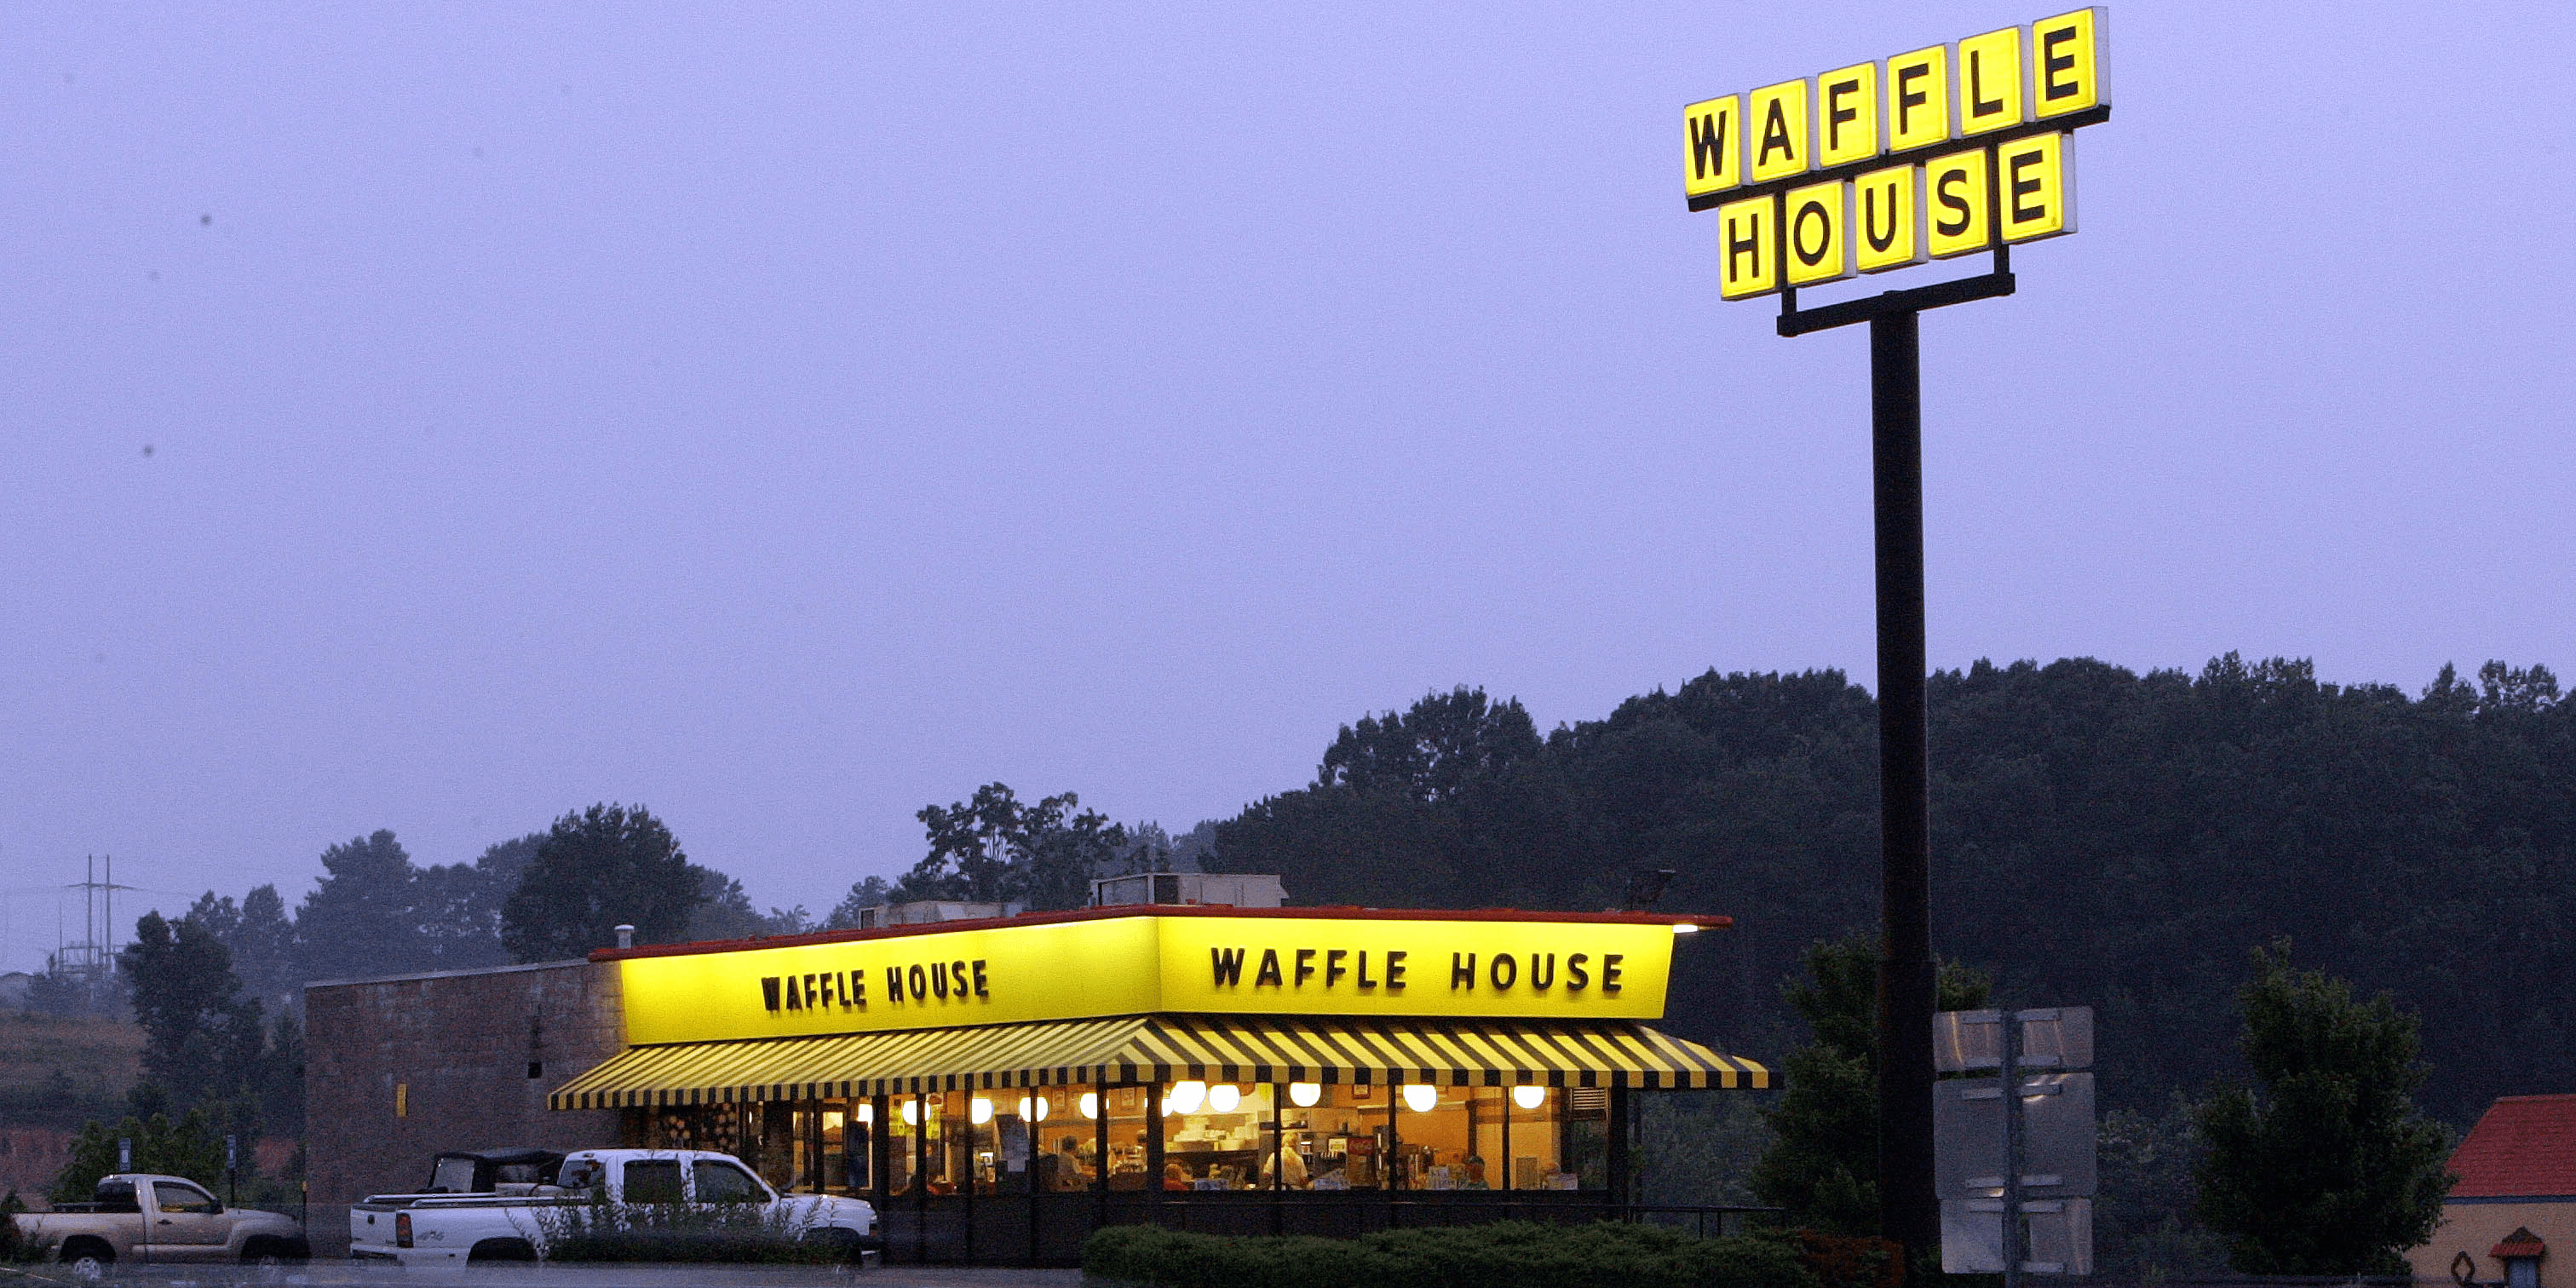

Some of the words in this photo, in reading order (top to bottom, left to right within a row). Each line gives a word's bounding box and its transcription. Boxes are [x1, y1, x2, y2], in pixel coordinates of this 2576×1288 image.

[1689, 26, 2079, 180] WAFFLE
[1728, 149, 2044, 283] HOUSE
[761, 969, 867, 1011] WAFFLE
[886, 959, 990, 1003] HOUSE
[1210, 947, 1407, 989] WAFFLE
[1451, 952, 1624, 992] HOUSE
